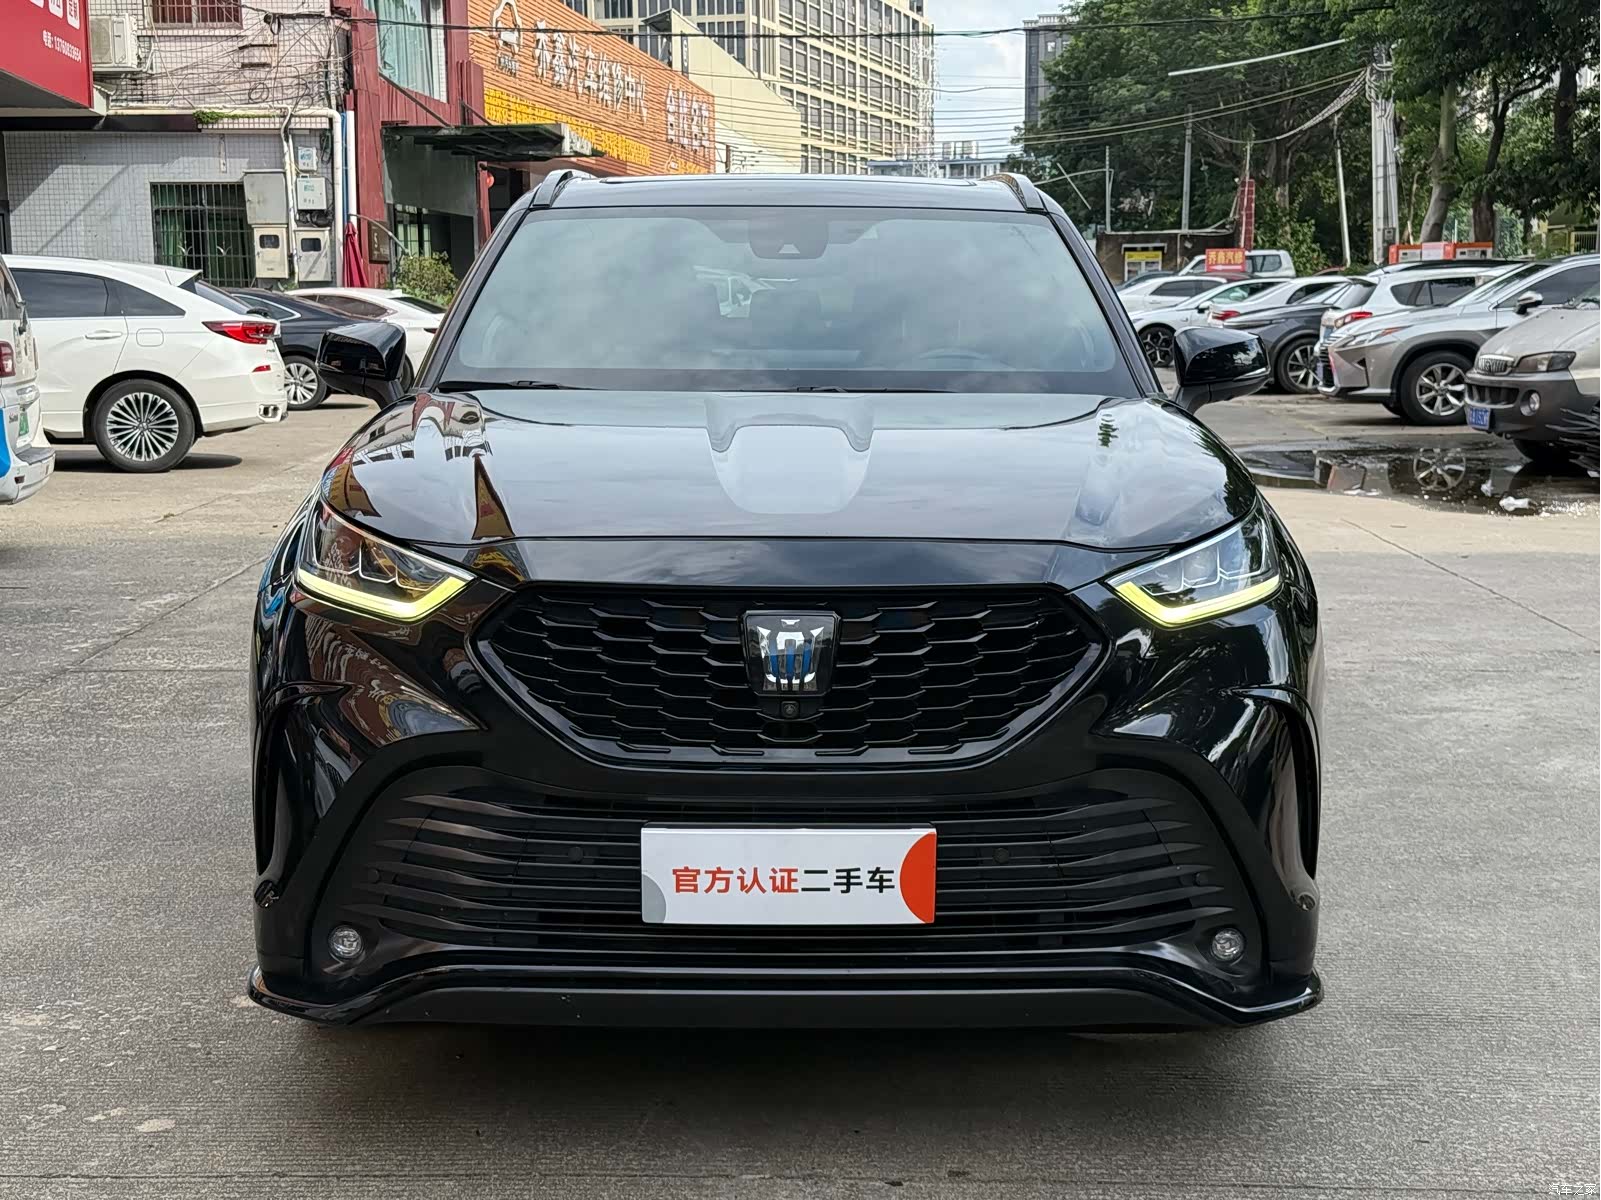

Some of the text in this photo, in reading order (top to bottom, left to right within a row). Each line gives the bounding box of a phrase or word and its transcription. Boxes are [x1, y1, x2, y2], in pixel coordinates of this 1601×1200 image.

[671, 866, 896, 894] 官方认证二手车
